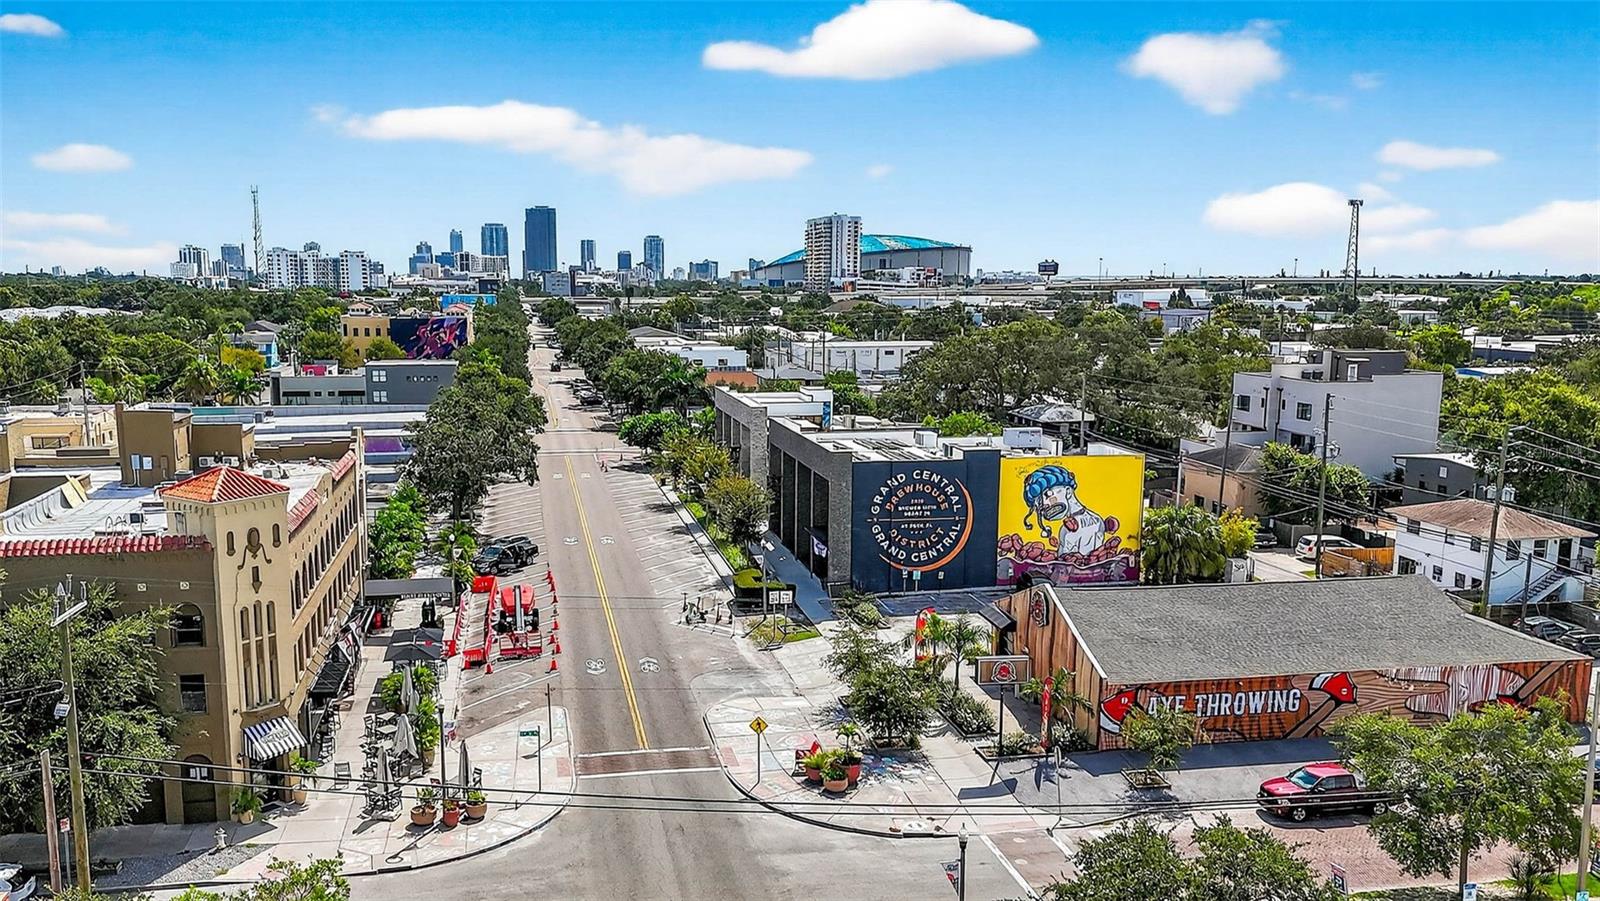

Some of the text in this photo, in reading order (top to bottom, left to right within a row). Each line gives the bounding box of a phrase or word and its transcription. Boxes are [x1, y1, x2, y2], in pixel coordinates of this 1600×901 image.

[871, 470, 962, 514] GRAND CENTRAL
[885, 483, 948, 512] BREWHOUSE
[872, 523, 961, 562] GRAND CENTRAL
[890, 527, 945, 549] DISTRICT
[1195, 688, 1301, 718] THROWING
